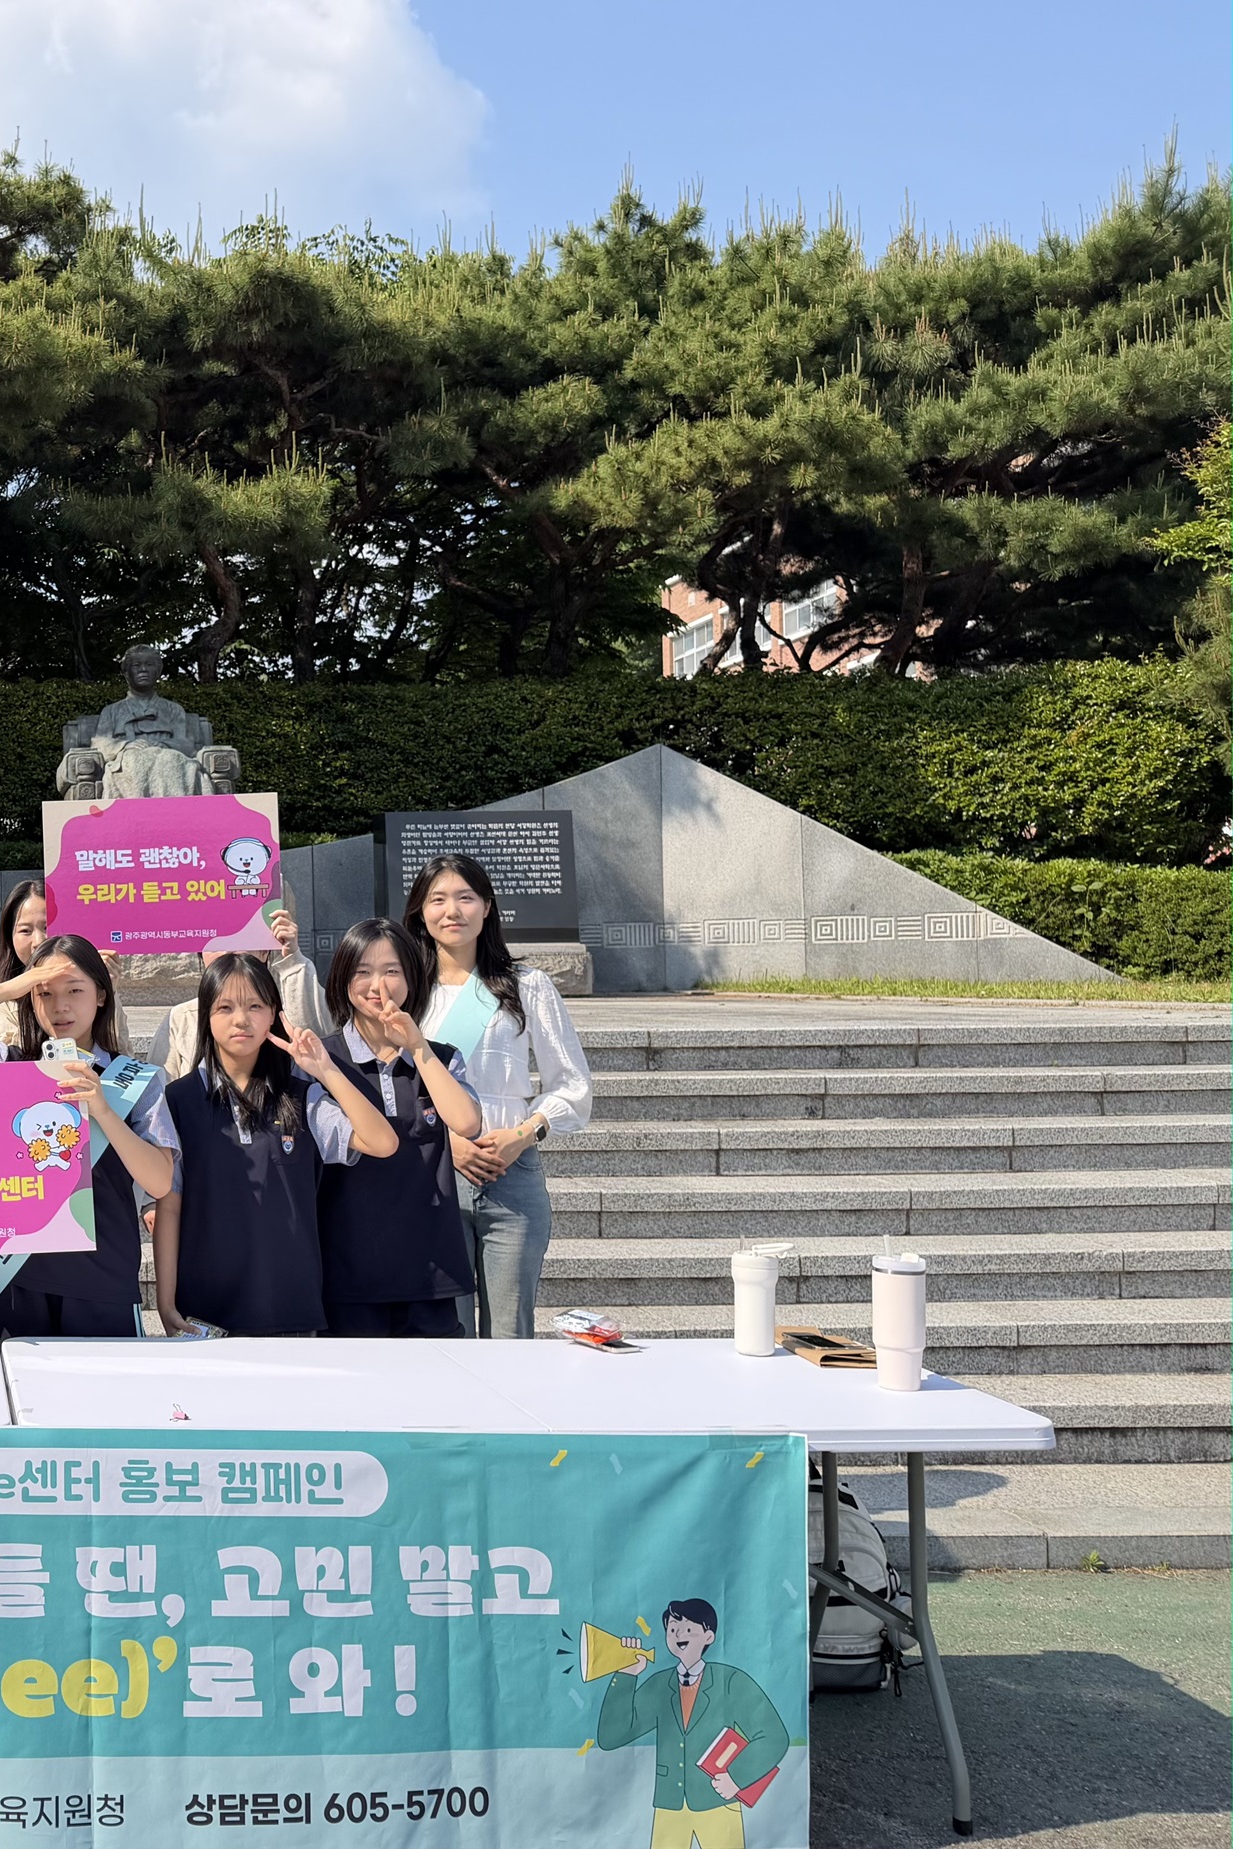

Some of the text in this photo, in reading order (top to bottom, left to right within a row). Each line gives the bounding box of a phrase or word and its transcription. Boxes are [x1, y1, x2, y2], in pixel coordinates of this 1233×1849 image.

[75, 846, 206, 871] 말해도 괜찮아,
[77, 879, 226, 904] 우리가 듣고 있어
[125, 928, 217, 941] 광주광역시동부교육지원청
[119, 1459, 204, 1505] 홍보
[218, 1461, 344, 1506] 캠페인
[76, 1544, 186, 1629] 땐,
[210, 1545, 375, 1619] 고민
[399, 1545, 560, 1617] 말고
[184, 1792, 312, 1827] 상담문의
[323, 1786, 490, 1825] 605-5700
